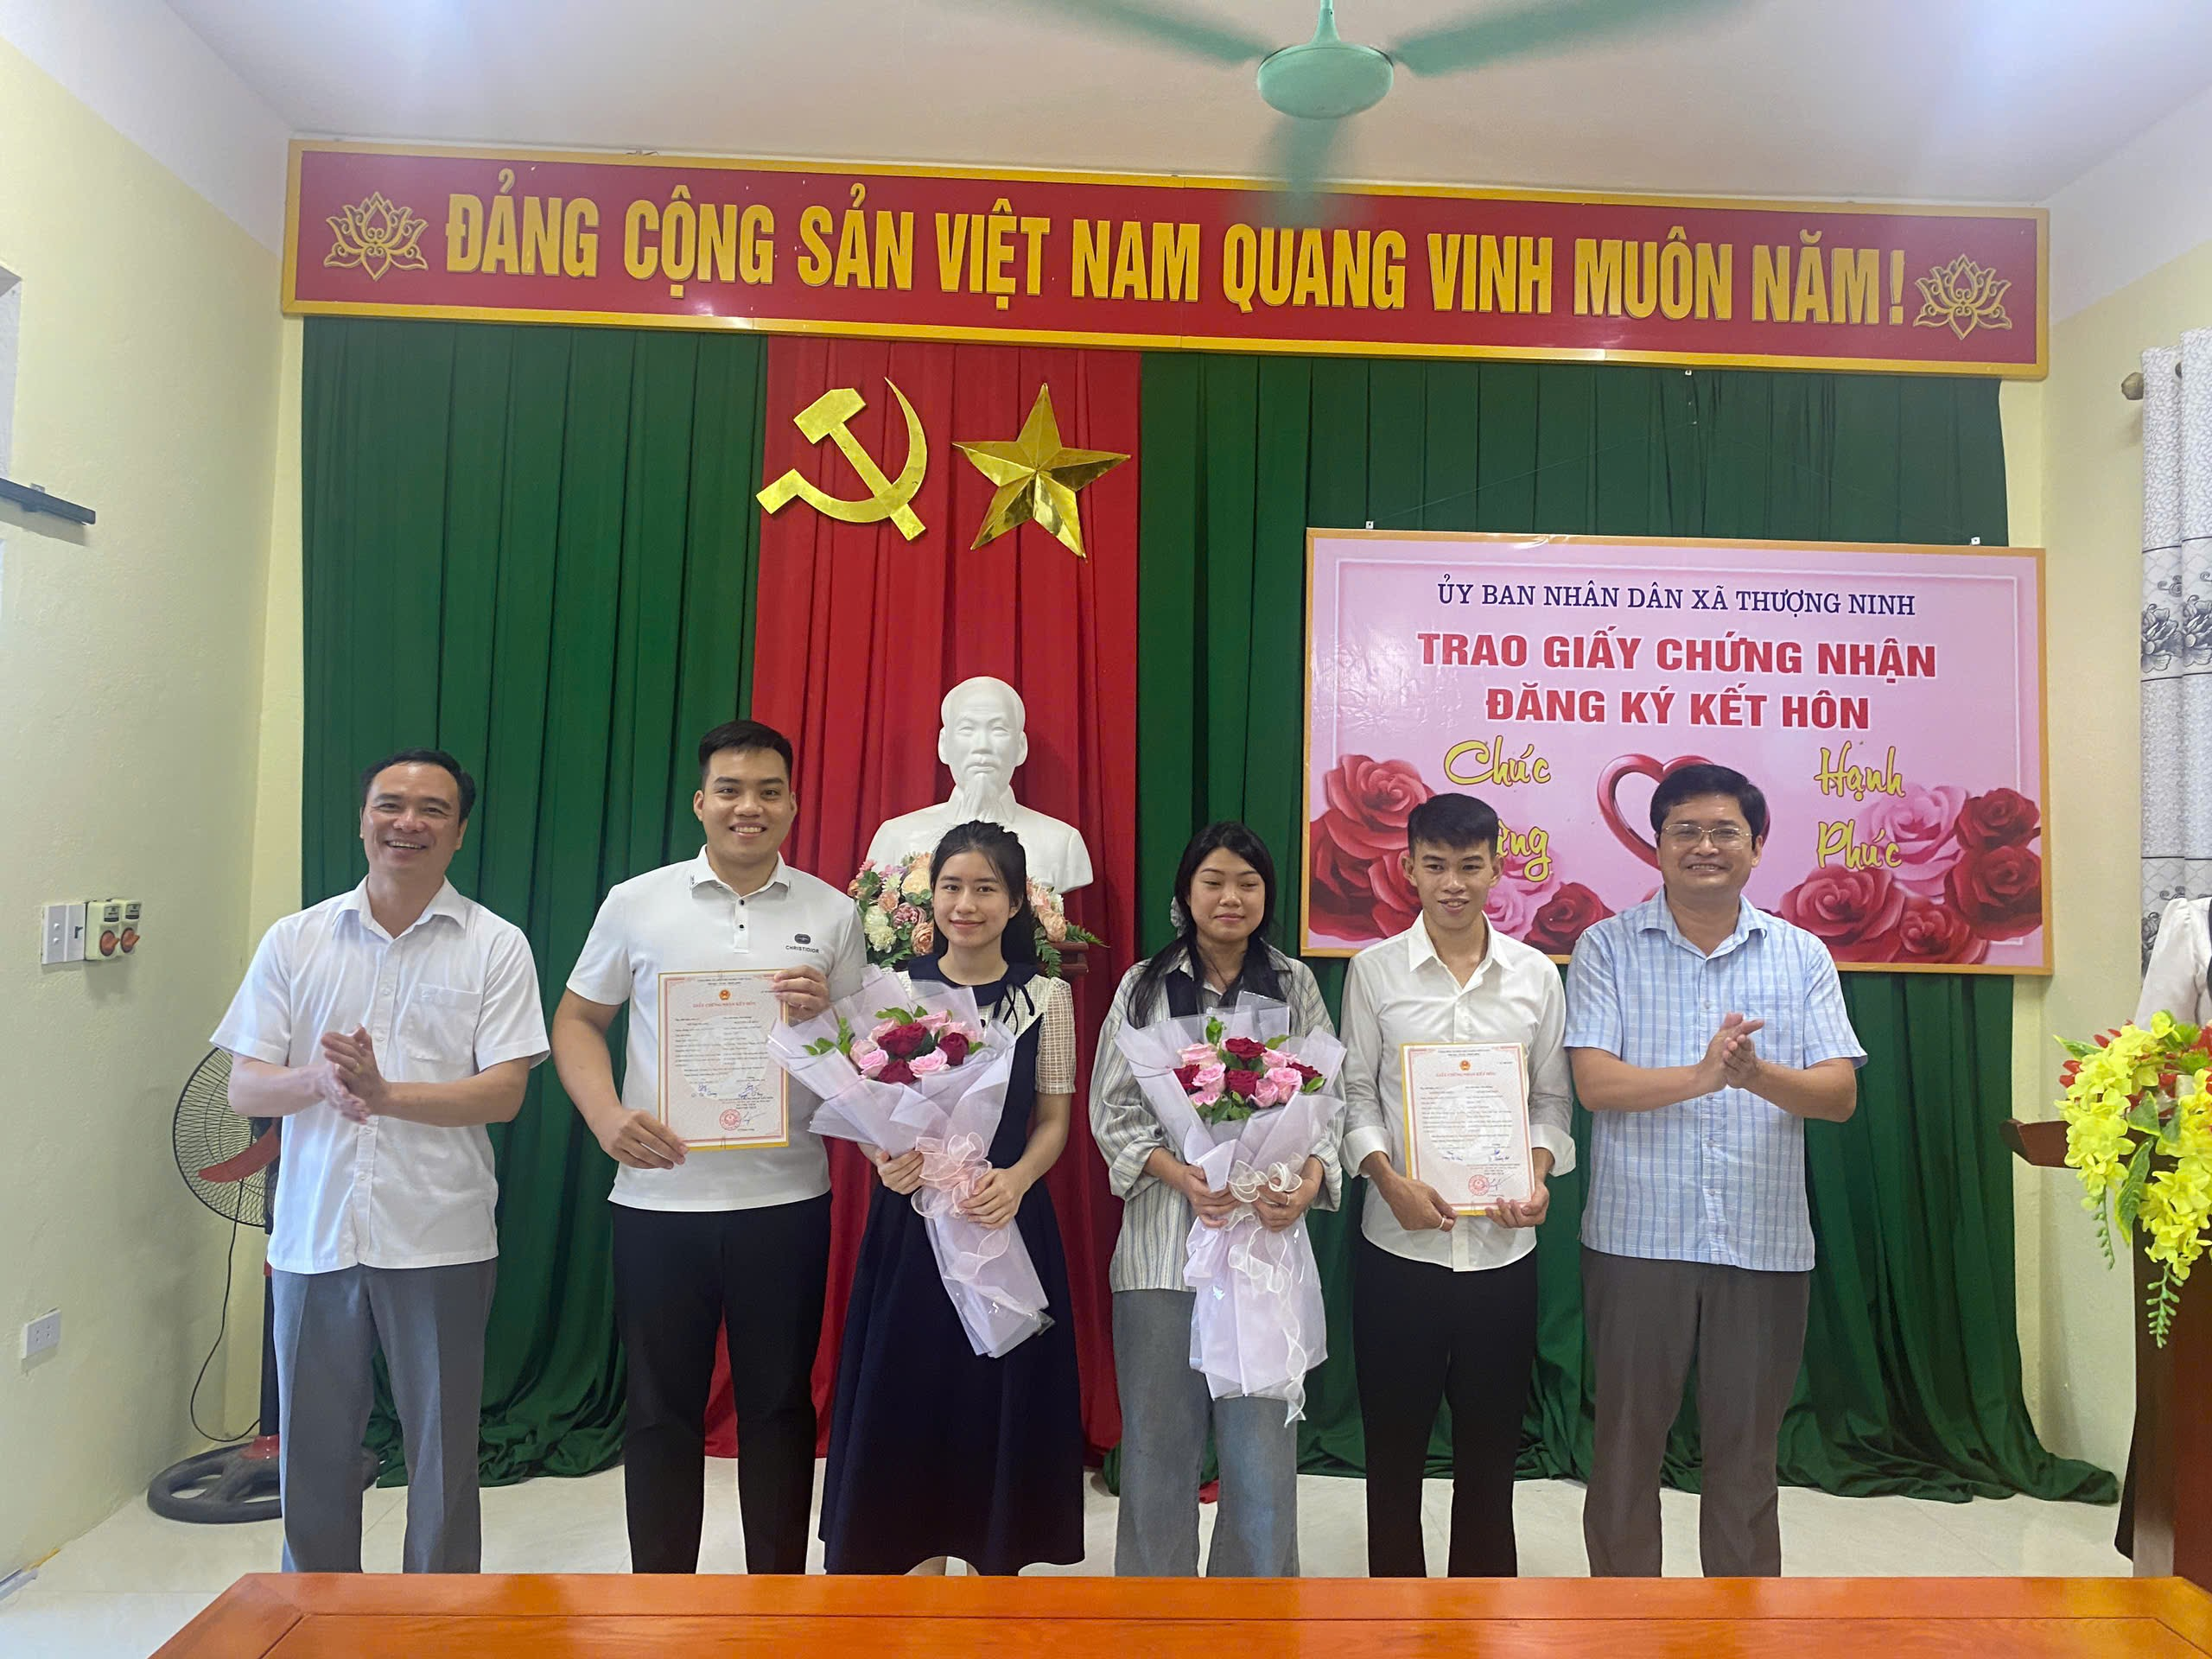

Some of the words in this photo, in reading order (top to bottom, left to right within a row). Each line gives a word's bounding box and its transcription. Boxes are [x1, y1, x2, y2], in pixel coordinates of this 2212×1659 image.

[446, 168, 598, 277] ĐẢNG
[624, 184, 774, 298] CỘNG
[798, 183, 914, 290] SẢN
[935, 197, 1051, 310] VIỆT
[1071, 219, 1199, 302] NAM
[1223, 223, 1406, 314] QUANG
[1427, 232, 1553, 315] VINH
[1574, 226, 1732, 321] MUÔN
[1438, 574, 1473, 604] ỦY
[1482, 585, 1535, 606] BAN
[1543, 580, 1619, 607] NHÂN
[1627, 582, 1683, 609] DÂN
[1691, 586, 1728, 610] XÃ
[1736, 588, 1841, 617] THƯỢNG
[1848, 594, 1916, 615] NINH
[1418, 633, 1527, 667] TRAO
[1543, 626, 1642, 669] GIẤY
[1656, 631, 1802, 674] CHỨNG
[1818, 638, 1936, 683] NHẬN
[1486, 682, 1605, 722] ĐĂNG
[1621, 685, 1675, 724] KÝ
[1690, 683, 1768, 727] KẾT
[1782, 690, 1868, 729] HÔN
[1444, 735, 1551, 786] Chúc
[1814, 741, 1906, 801] Hạnh
[1497, 818, 1553, 882] ừng
[1816, 819, 1903, 870] Phúc
